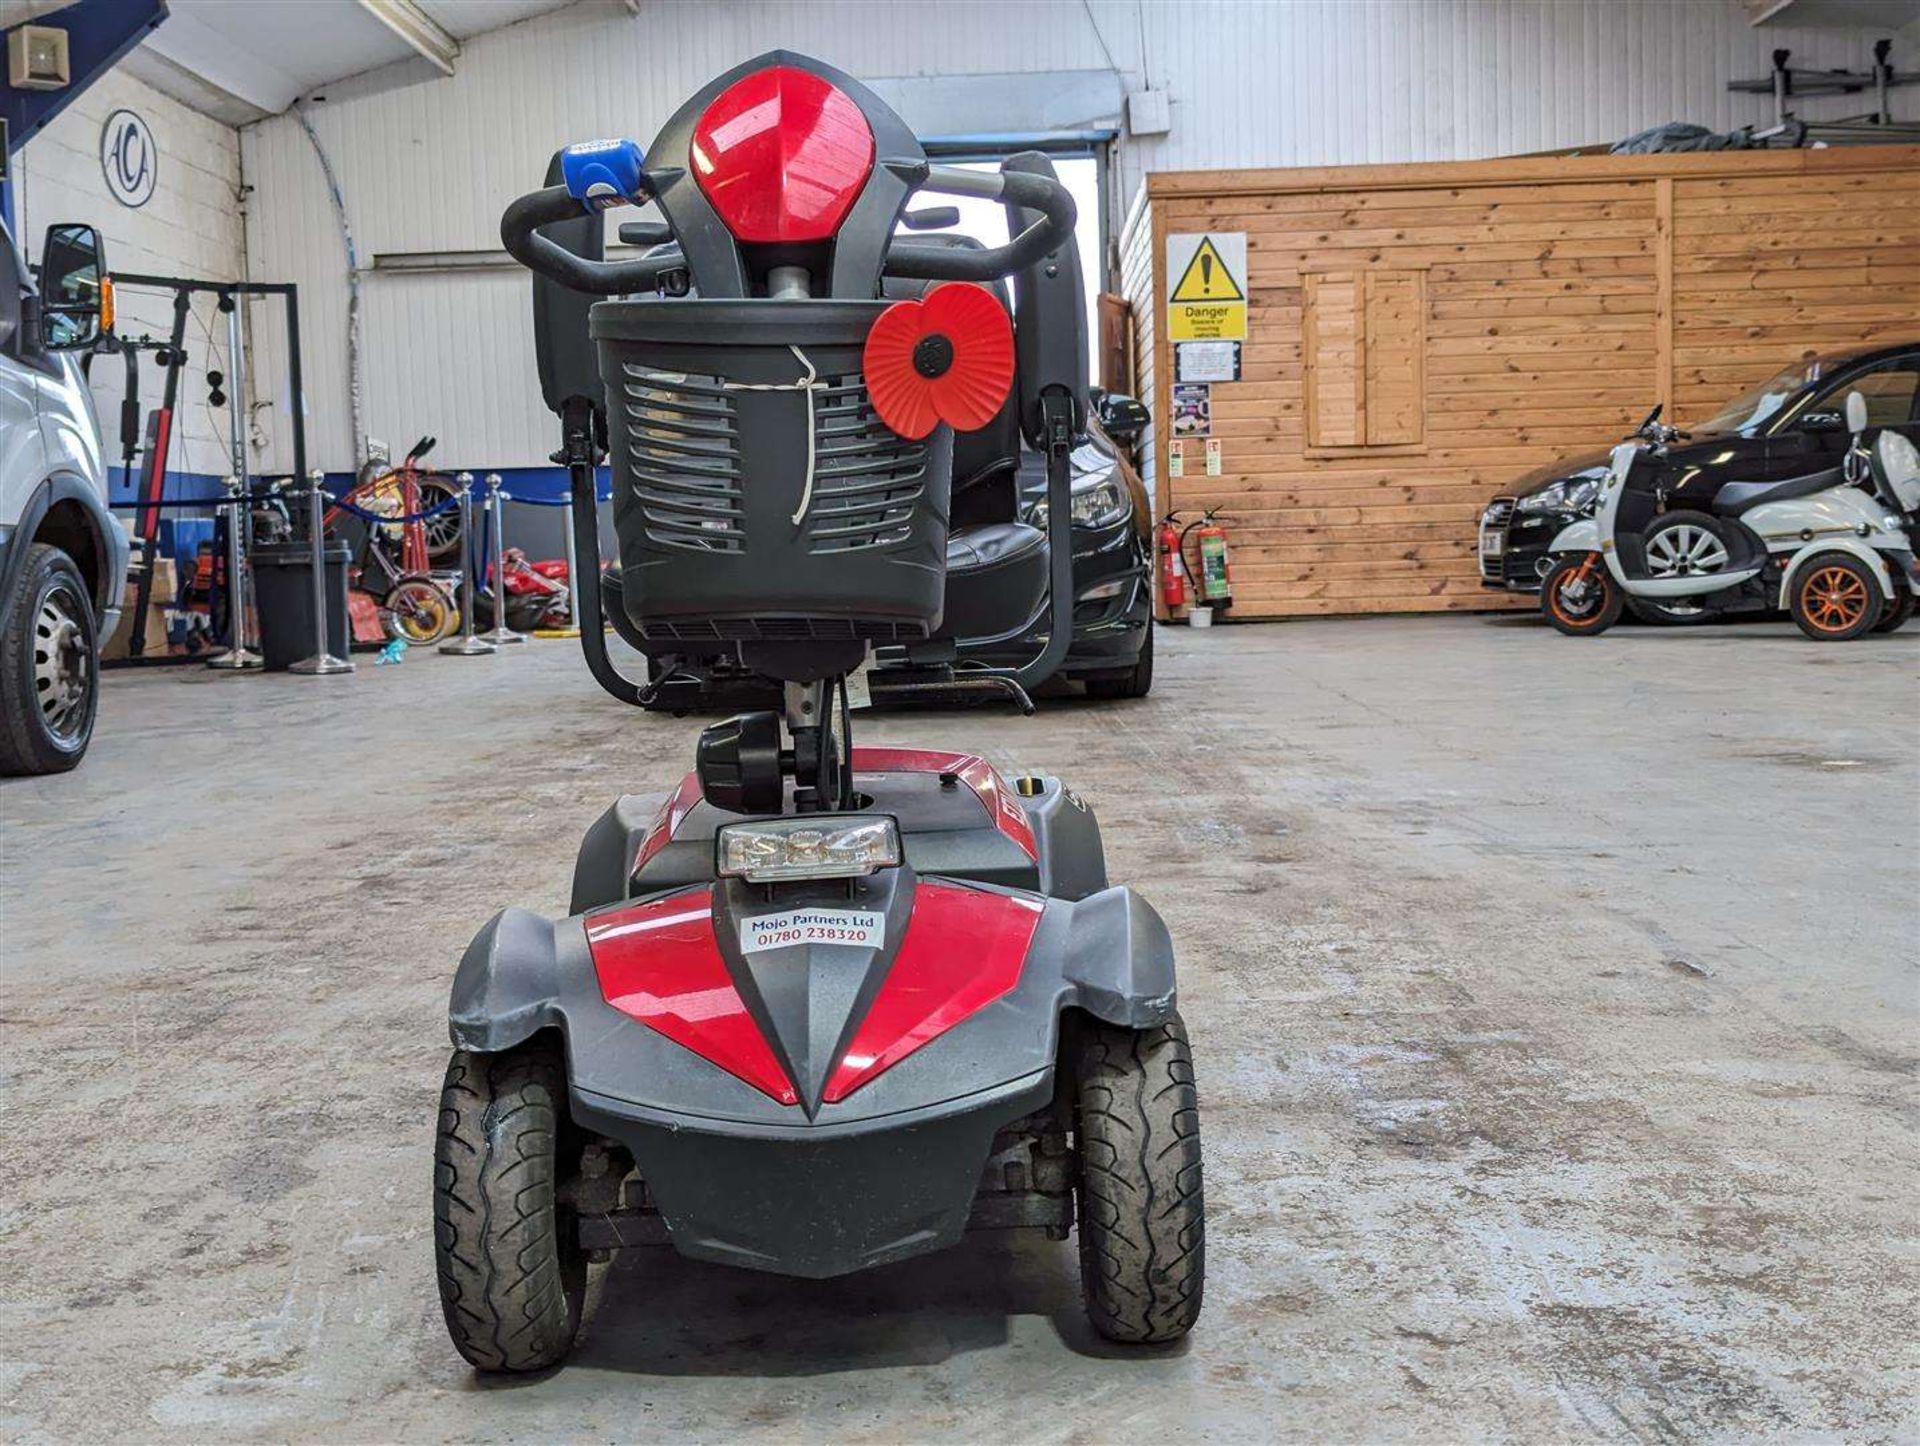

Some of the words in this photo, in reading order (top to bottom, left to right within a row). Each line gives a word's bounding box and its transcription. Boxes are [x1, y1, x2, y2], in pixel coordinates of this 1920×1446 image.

[1185, 306, 1229, 318] Danger
[752, 918, 787, 932] Mojo
[793, 915, 848, 926] Partners
[853, 916, 874, 928] Ltd
[758, 929, 801, 946] 01780
[807, 927, 867, 941] 238320
